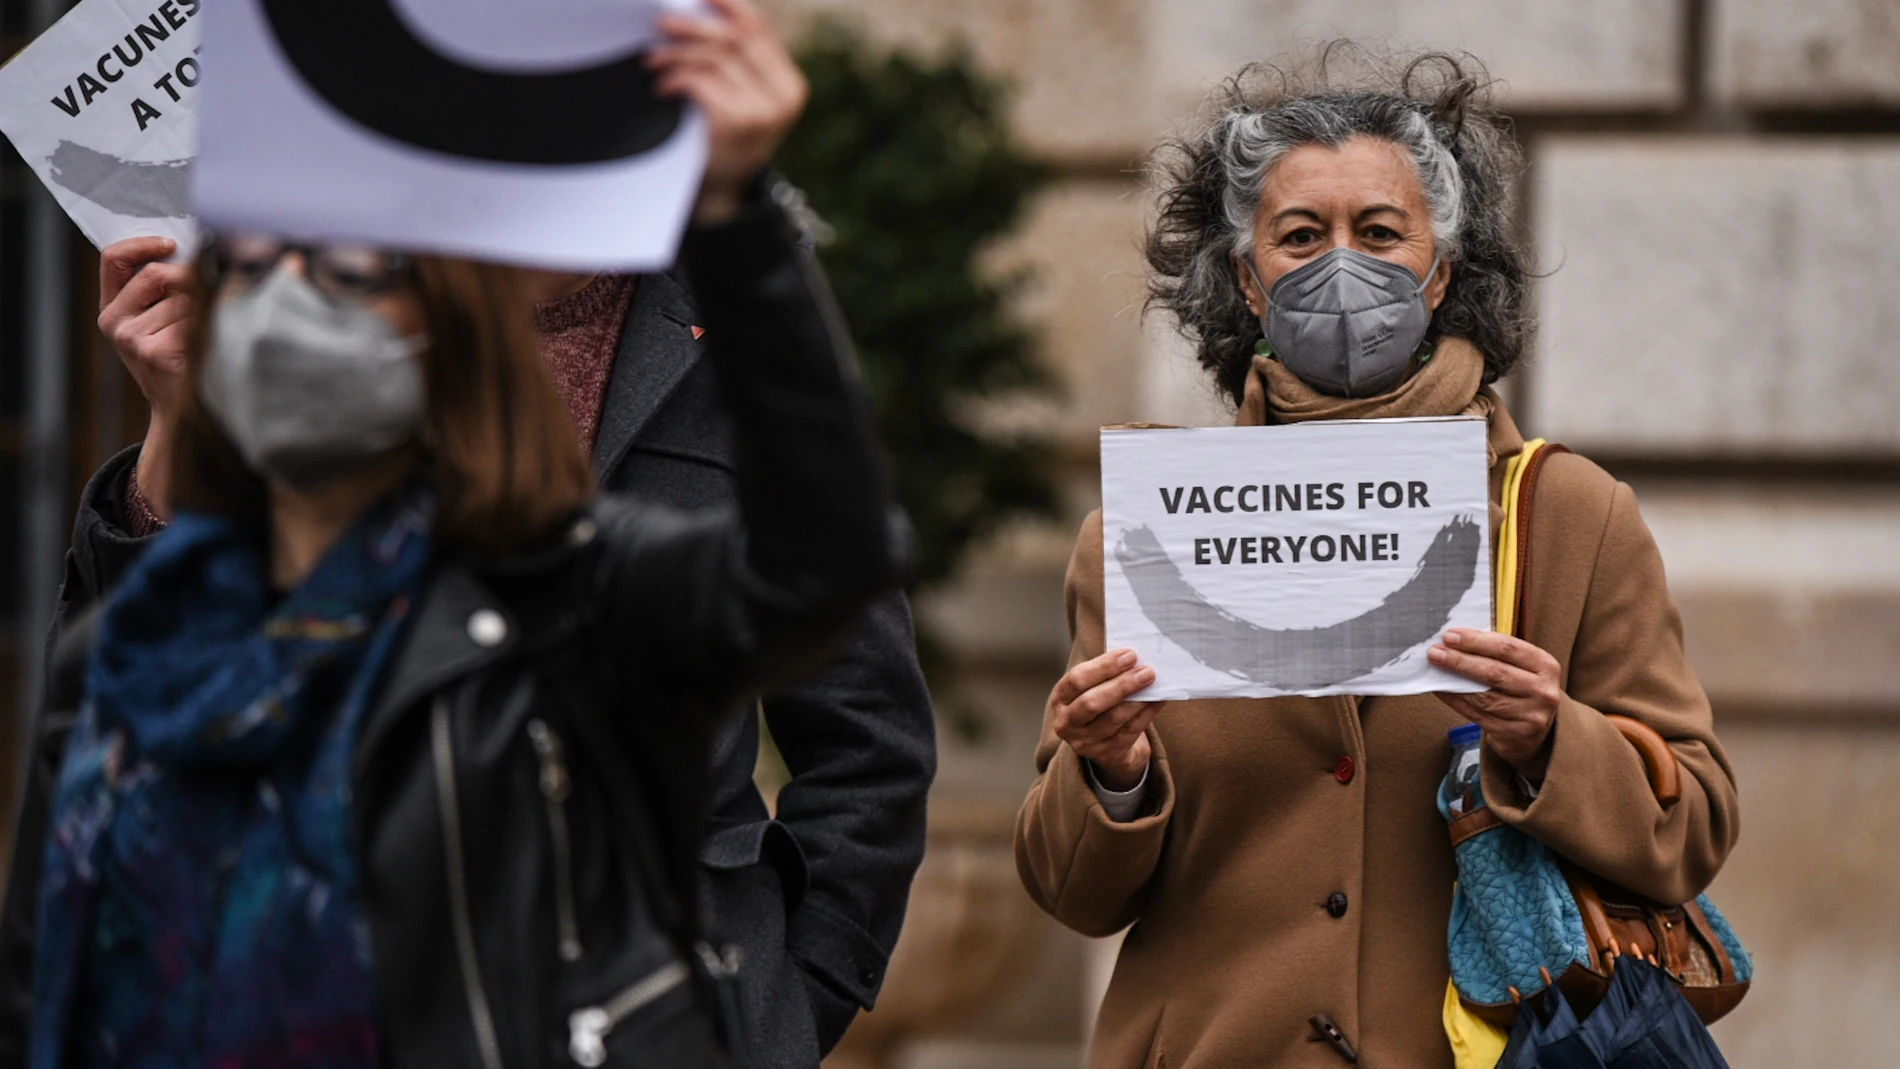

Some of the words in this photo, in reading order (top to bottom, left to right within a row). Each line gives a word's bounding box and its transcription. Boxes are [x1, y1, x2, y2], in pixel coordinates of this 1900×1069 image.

[130, 97, 162, 131] A
[153, 45, 203, 102] TO
[1159, 482, 1345, 514] VACCINES
[1357, 480, 1430, 510] FOR
[1194, 533, 1400, 565] EVERYONE!
